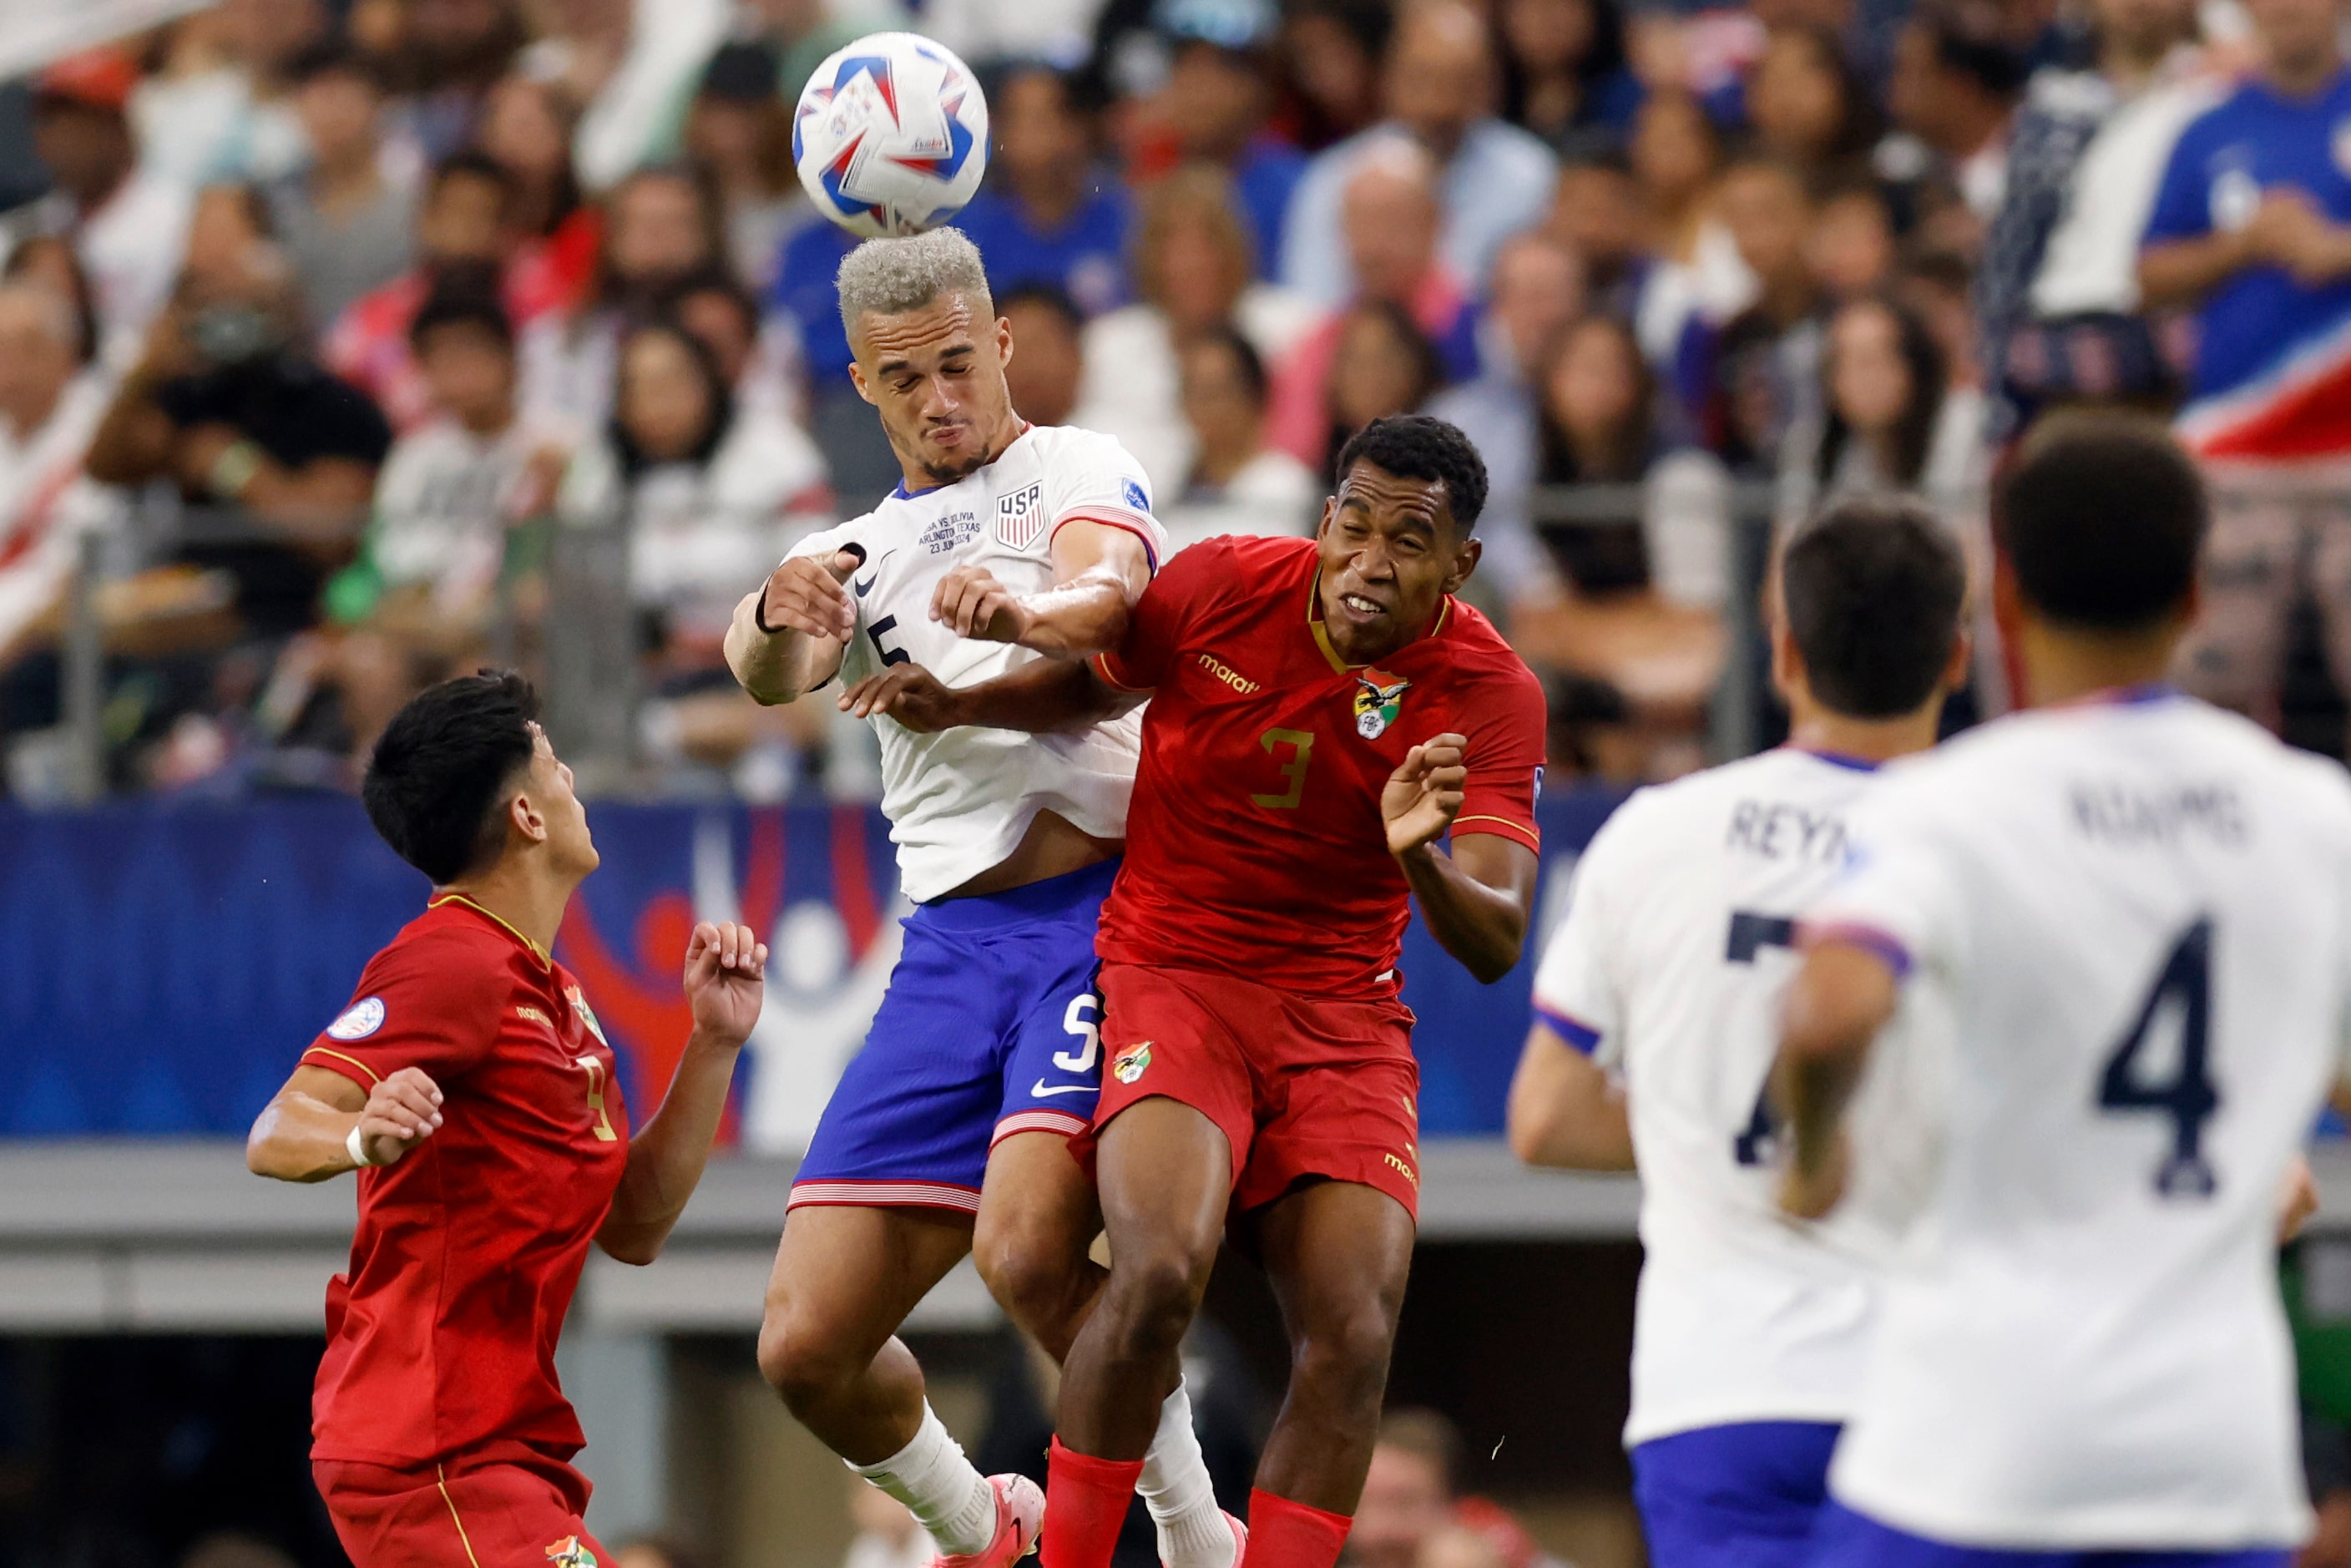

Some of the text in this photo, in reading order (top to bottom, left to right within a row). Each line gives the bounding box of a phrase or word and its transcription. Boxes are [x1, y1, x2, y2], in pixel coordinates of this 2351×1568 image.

[1001, 485, 1039, 515] USA
[918, 522, 981, 545] ARLINGTO TEXAS
[923, 521, 938, 534] SA
[929, 543, 941, 554] 23
[955, 533, 970, 545] 2024
[867, 614, 911, 668] 5
[1198, 654, 1260, 694] marat
[1251, 727, 1315, 808] 3
[1052, 994, 1099, 1073] 5
[2098, 912, 2217, 1199] 4
[576, 1055, 618, 1141] 9
